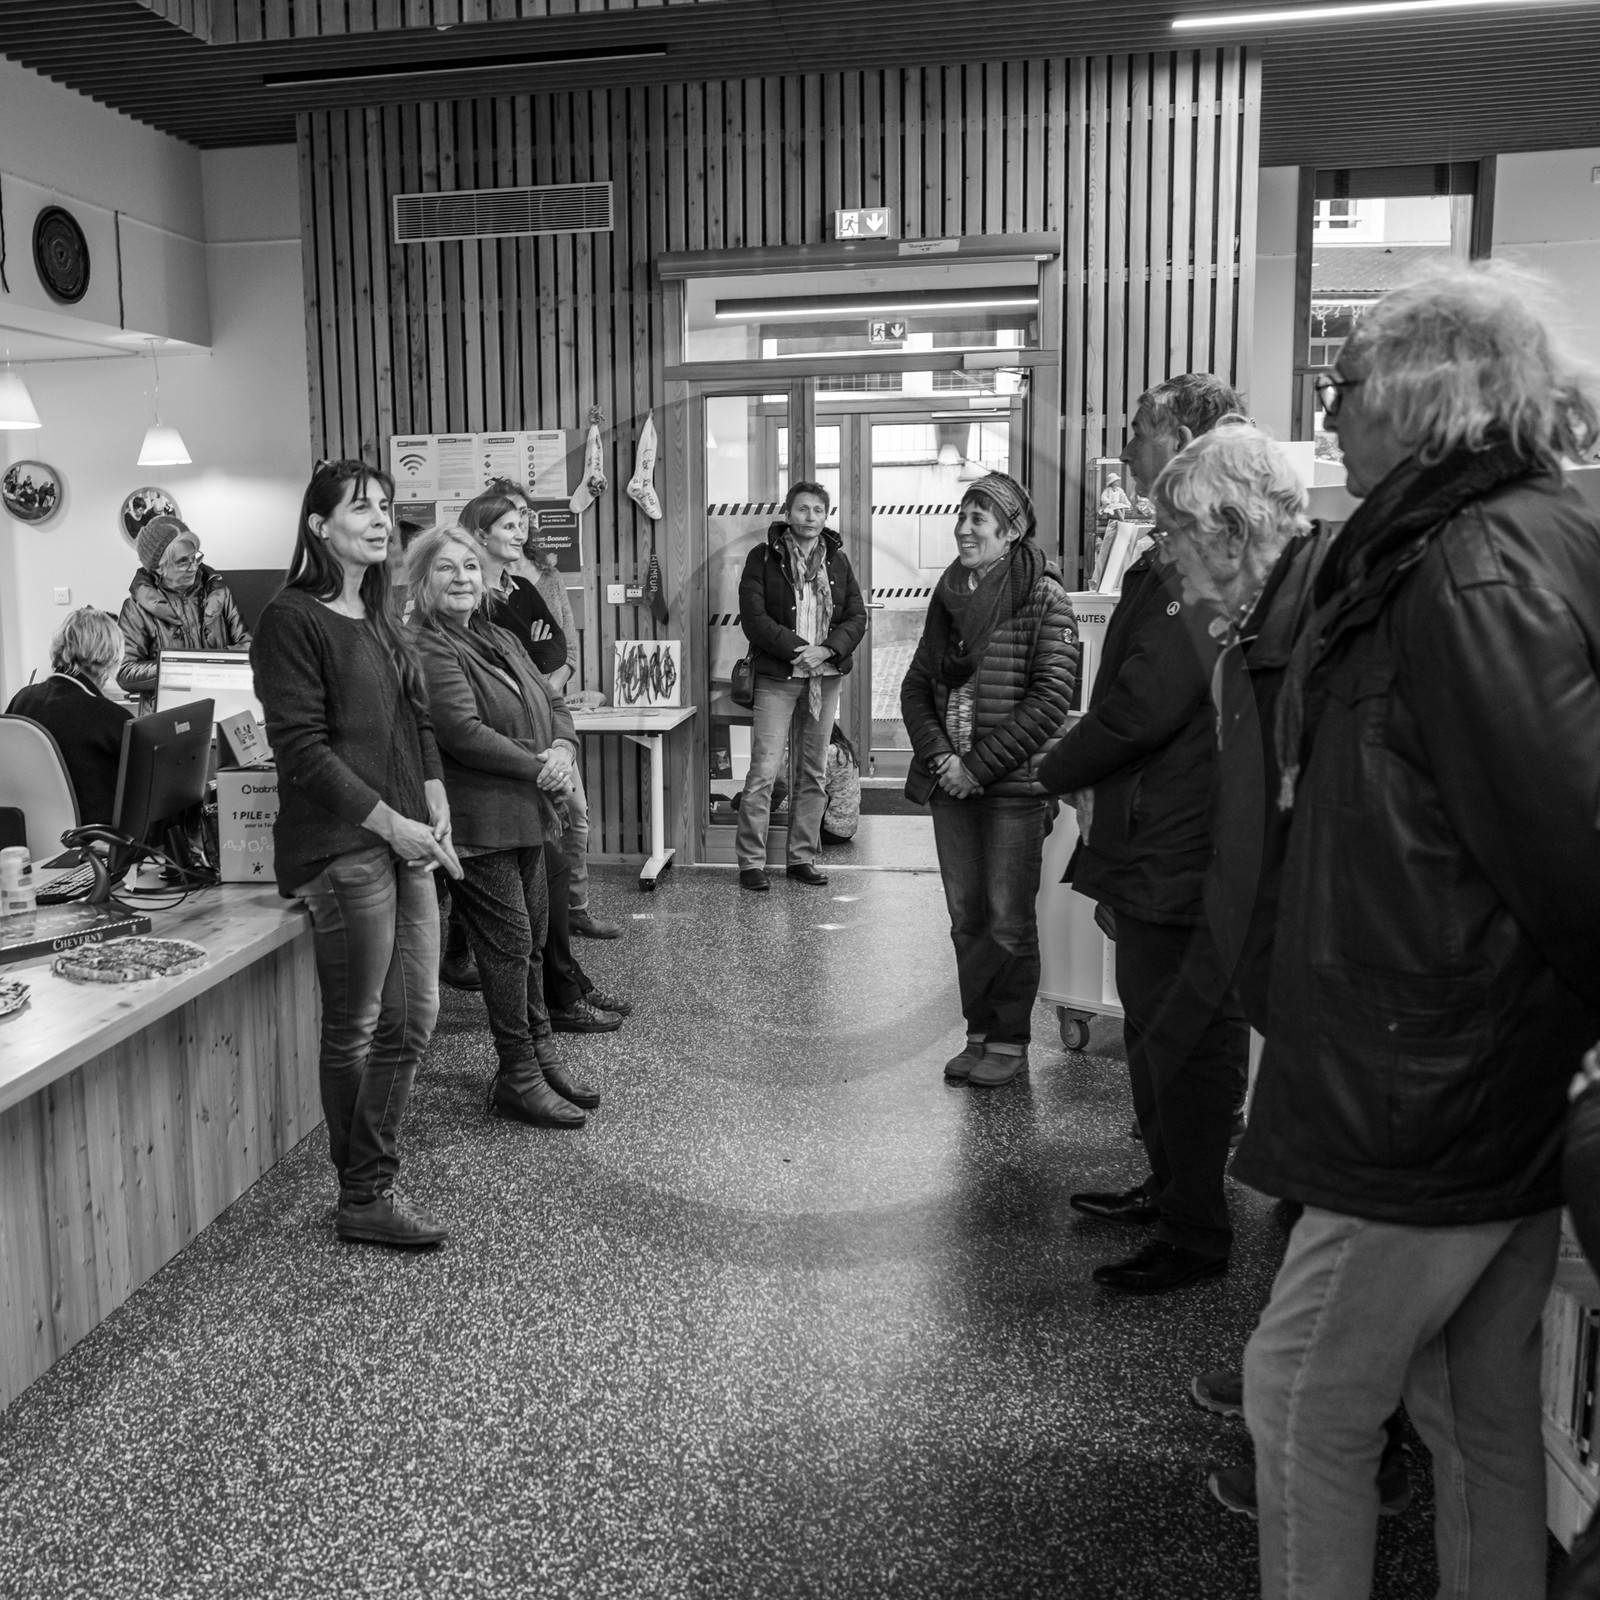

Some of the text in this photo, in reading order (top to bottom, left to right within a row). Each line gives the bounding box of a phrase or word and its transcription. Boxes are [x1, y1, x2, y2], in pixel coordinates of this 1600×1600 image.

[650, 554, 658, 592] HUMEUR
[240, 811, 263, 820] PILE
[52, 931, 104, 951] CHEVERNY
